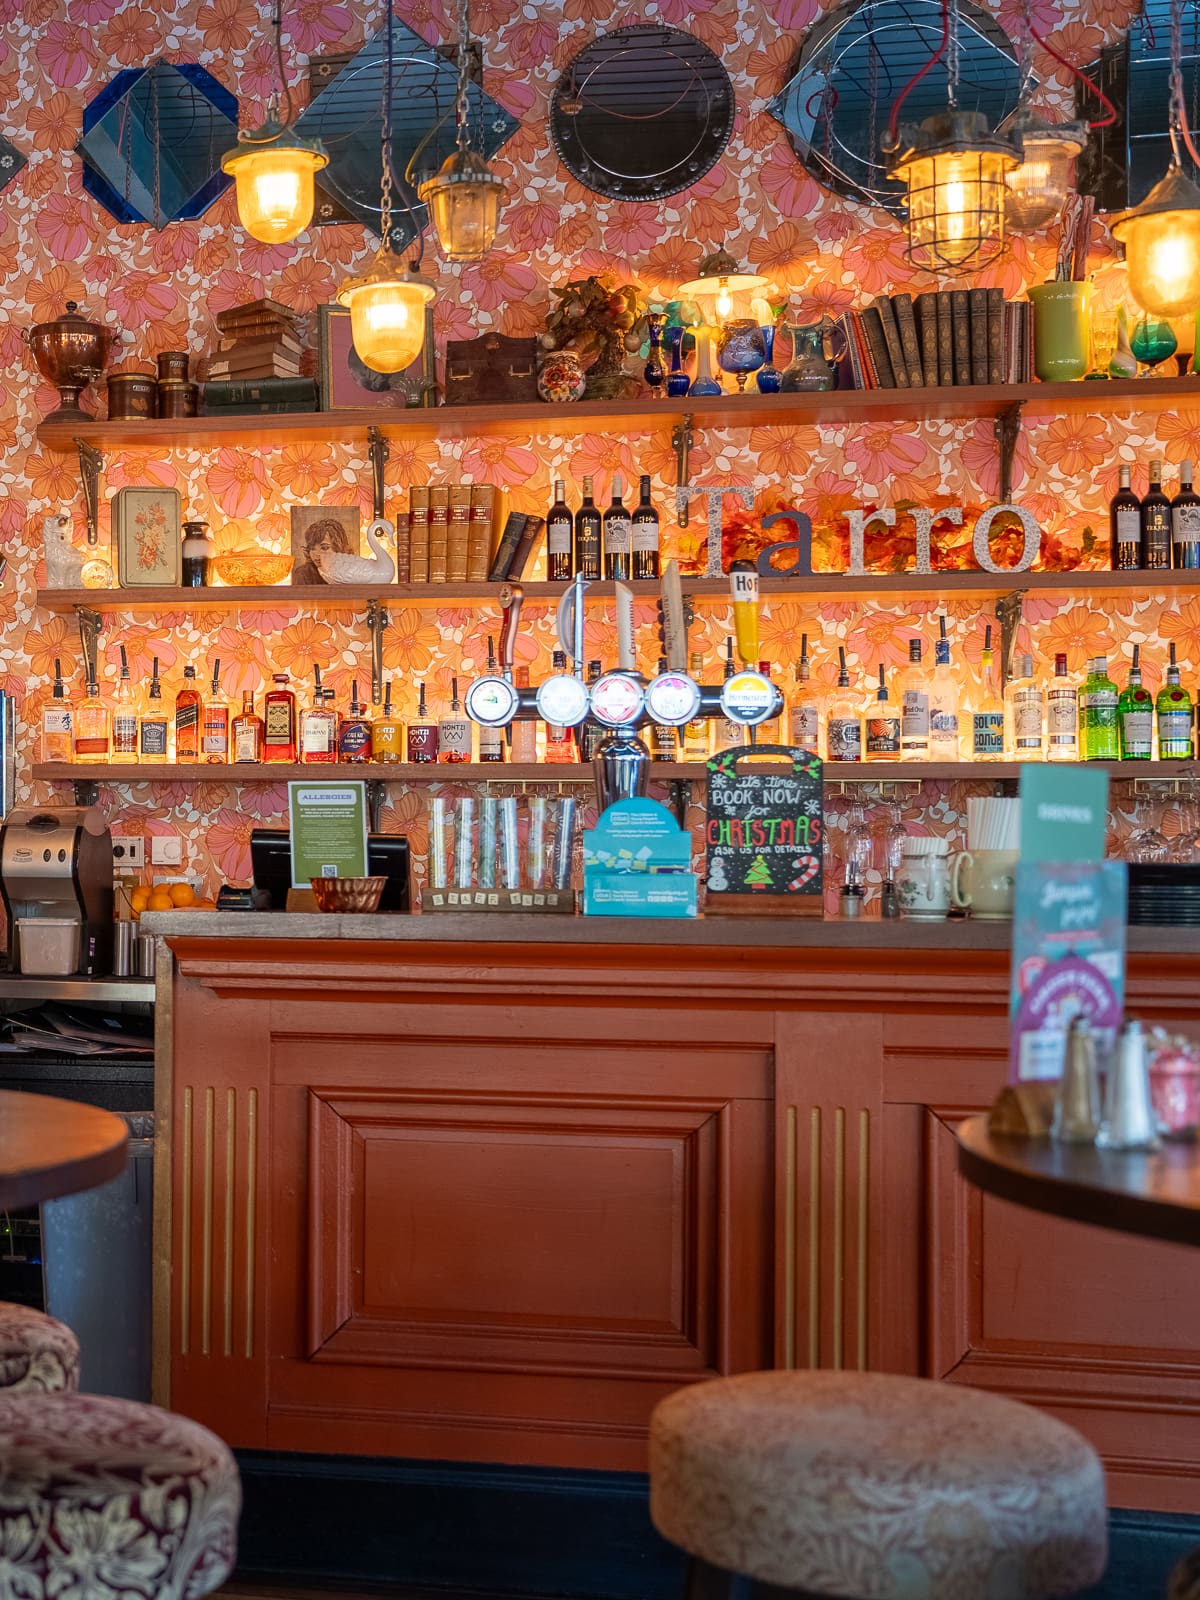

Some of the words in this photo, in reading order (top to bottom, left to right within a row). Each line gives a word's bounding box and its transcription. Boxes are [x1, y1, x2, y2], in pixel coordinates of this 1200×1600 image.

[676, 486, 1041, 578] Tarro
[712, 790, 753, 805] BOOK
[763, 789, 800, 804] NOW
[744, 805, 771, 820] for
[707, 816, 821, 847] CHRISTMAS
[714, 846, 735, 855] ASK
[740, 845, 753, 855] US
[755, 845, 771, 854] FOR
[774, 845, 813, 854] DETAILS
